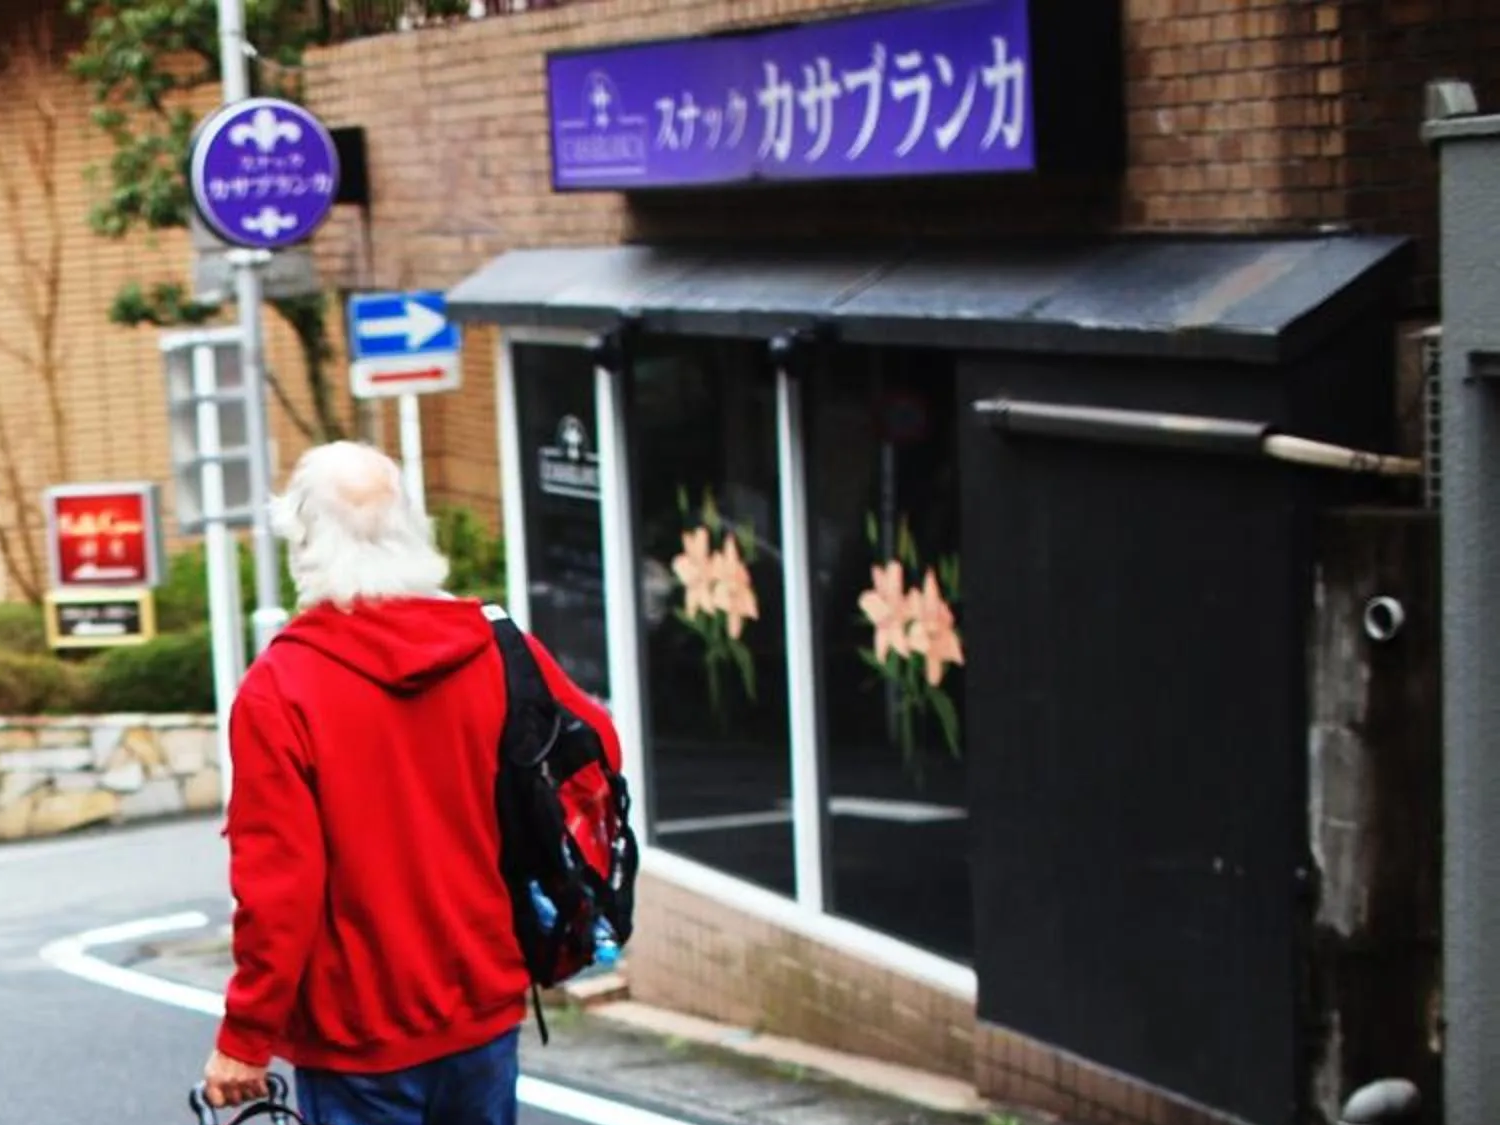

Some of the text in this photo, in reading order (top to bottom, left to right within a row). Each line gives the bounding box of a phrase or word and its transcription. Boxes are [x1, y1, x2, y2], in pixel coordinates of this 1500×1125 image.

[655, 37, 1025, 162] スナック カサブランカ
